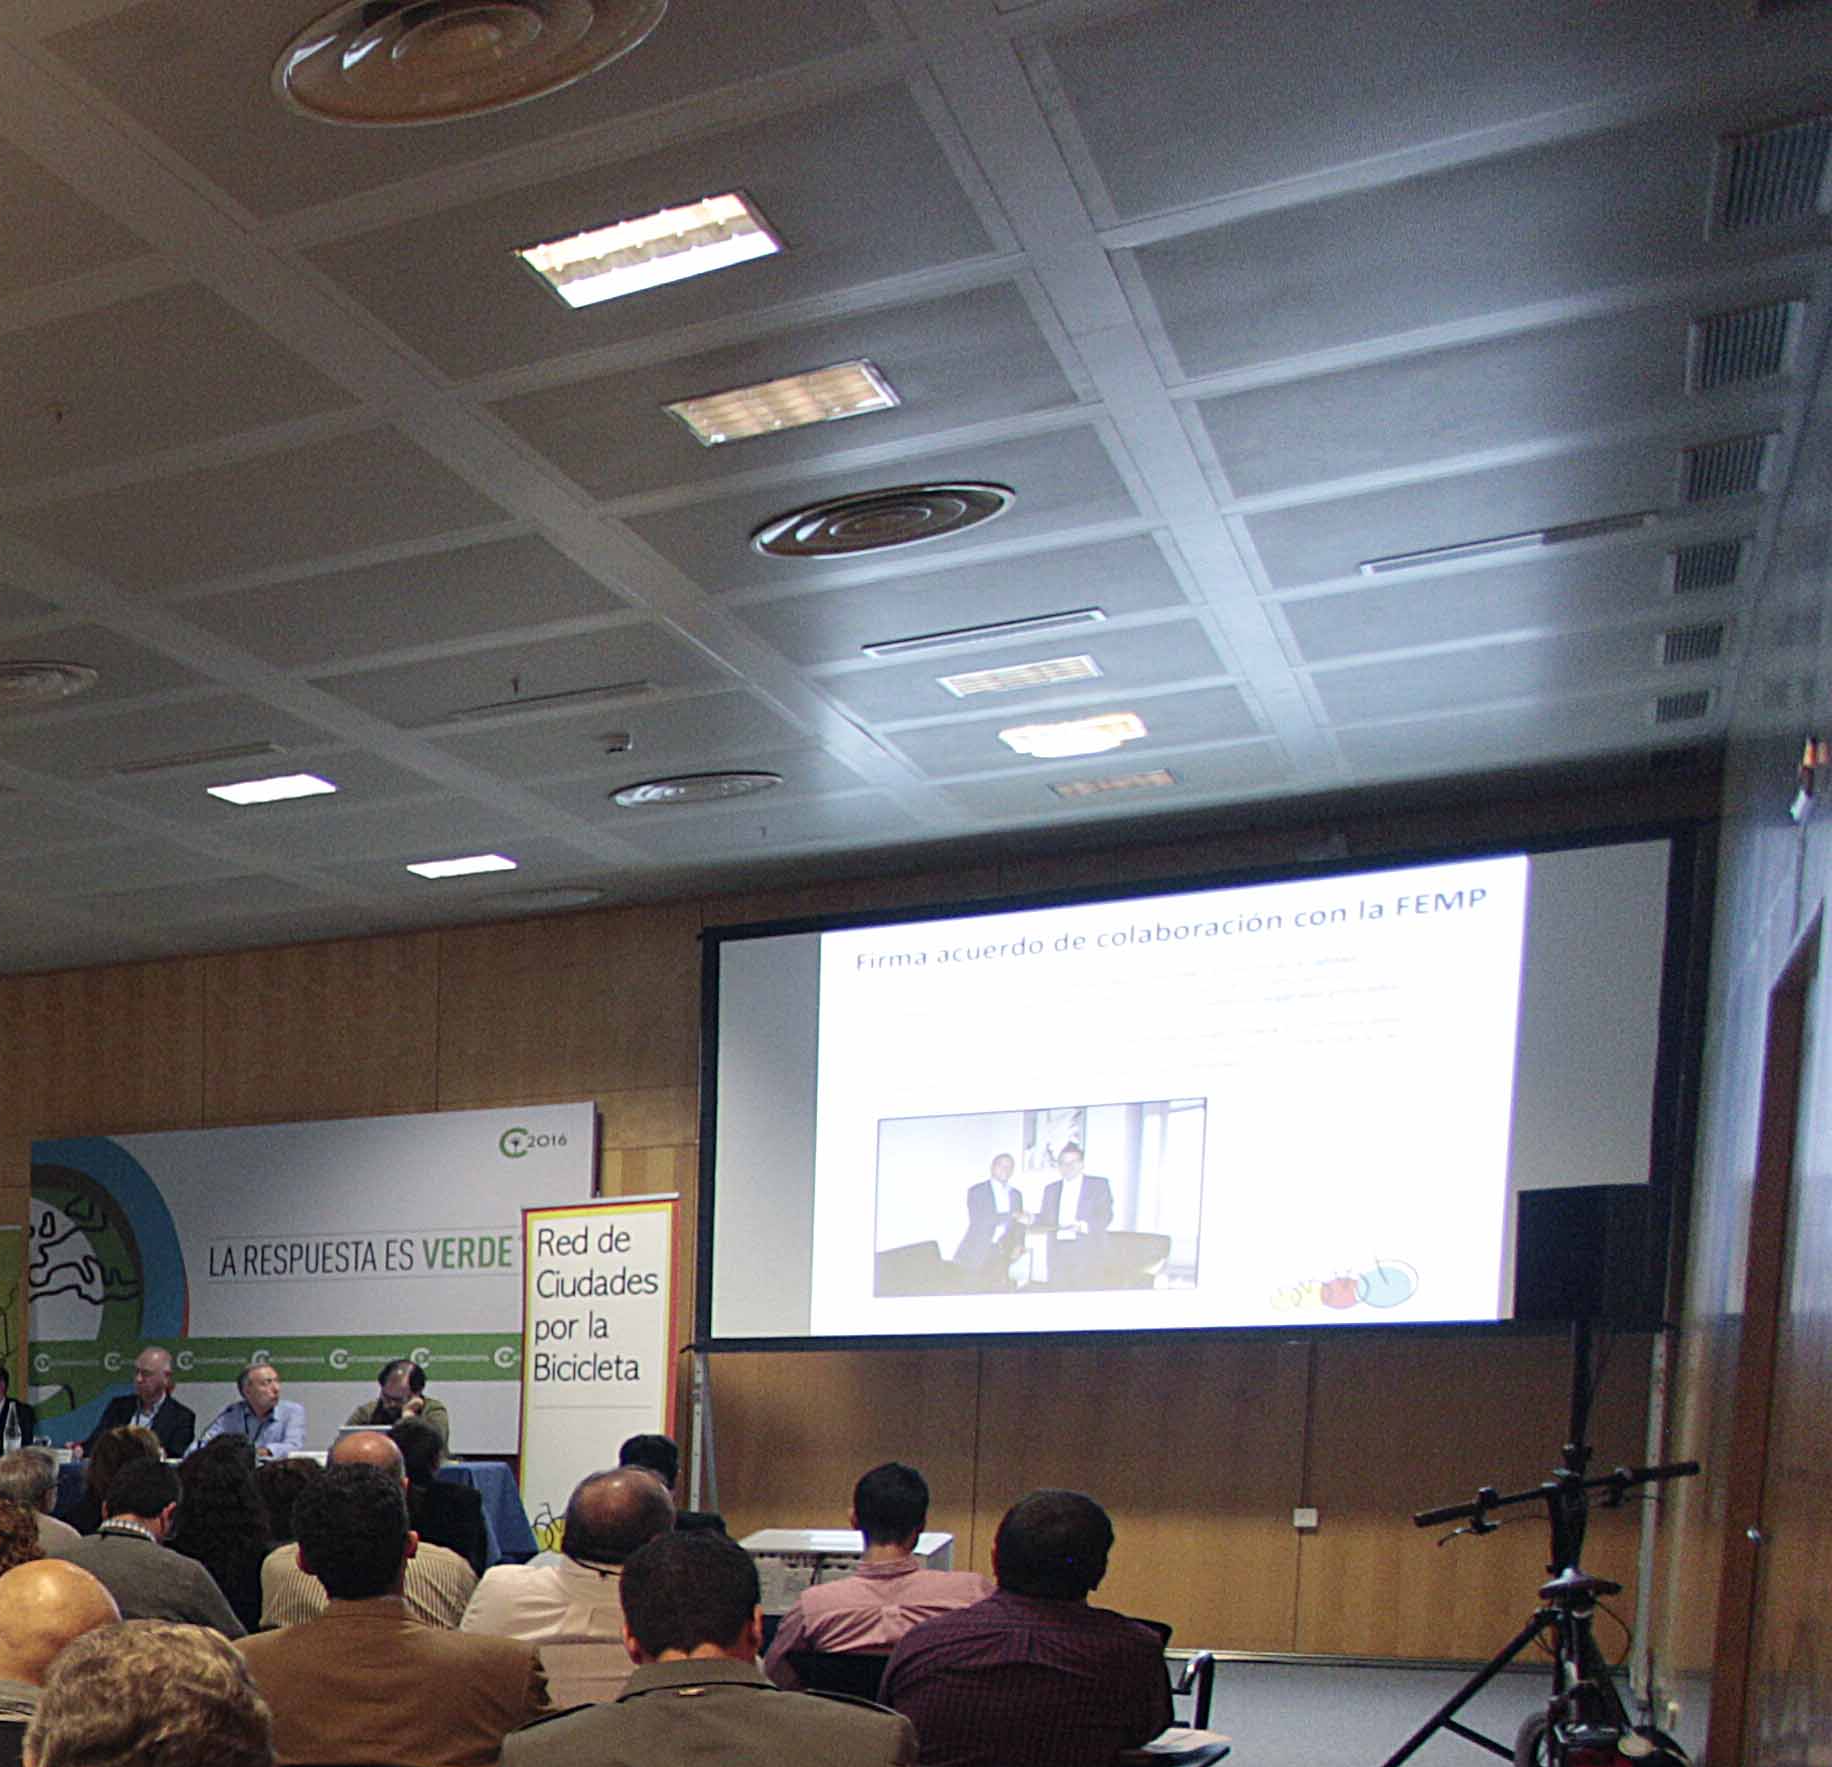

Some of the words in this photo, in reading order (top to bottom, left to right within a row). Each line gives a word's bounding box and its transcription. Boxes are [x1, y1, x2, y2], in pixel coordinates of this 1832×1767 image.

[856, 952, 928, 971] Firma
[937, 938, 1044, 965] acuerdo
[1054, 933, 1086, 952] de
[1097, 913, 1282, 948] colaboración
[1294, 908, 1347, 928] con
[1359, 900, 1384, 920] la
[1397, 888, 1487, 916] FEMP
[528, 1131, 568, 1148] 2016
[209, 1246, 237, 1278] LA
[244, 1240, 377, 1277] RESPUESTA
[386, 1239, 414, 1272] ES
[422, 1235, 513, 1269] VERDE
[537, 1225, 589, 1257] Red
[598, 1224, 631, 1254] de
[536, 1266, 659, 1299] Ciudades
[534, 1318, 579, 1346] por
[588, 1310, 609, 1339] la
[534, 1352, 640, 1382] Bicicleta
